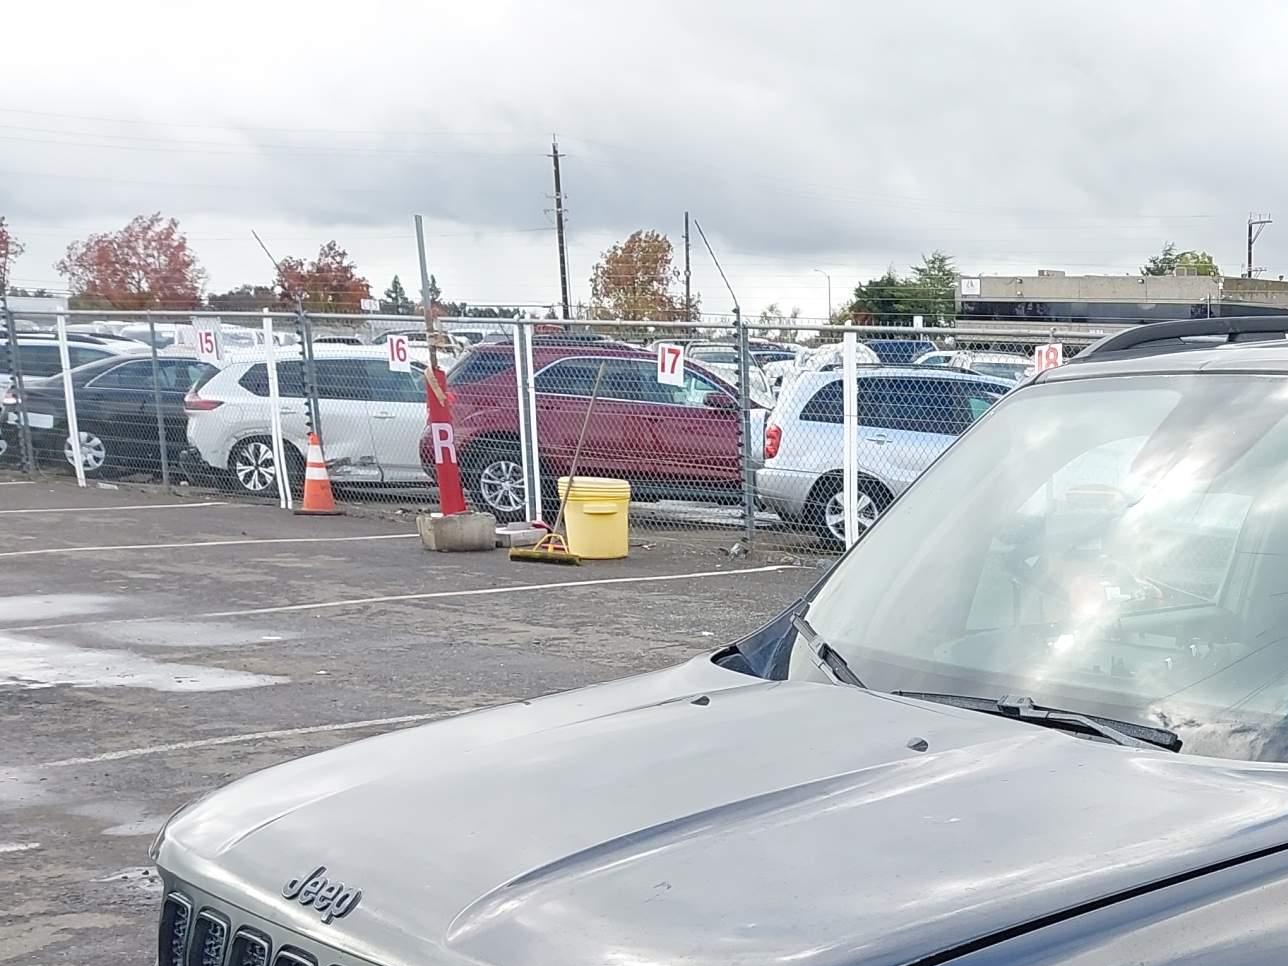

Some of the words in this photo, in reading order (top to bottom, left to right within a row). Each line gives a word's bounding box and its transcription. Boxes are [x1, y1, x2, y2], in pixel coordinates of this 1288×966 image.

[199, 332, 214, 354] 15
[389, 337, 407, 362] 16
[660, 347, 681, 374] 17
[1037, 347, 1059, 371] 18
[431, 422, 457, 464] R
[282, 866, 363, 925] Jeep
